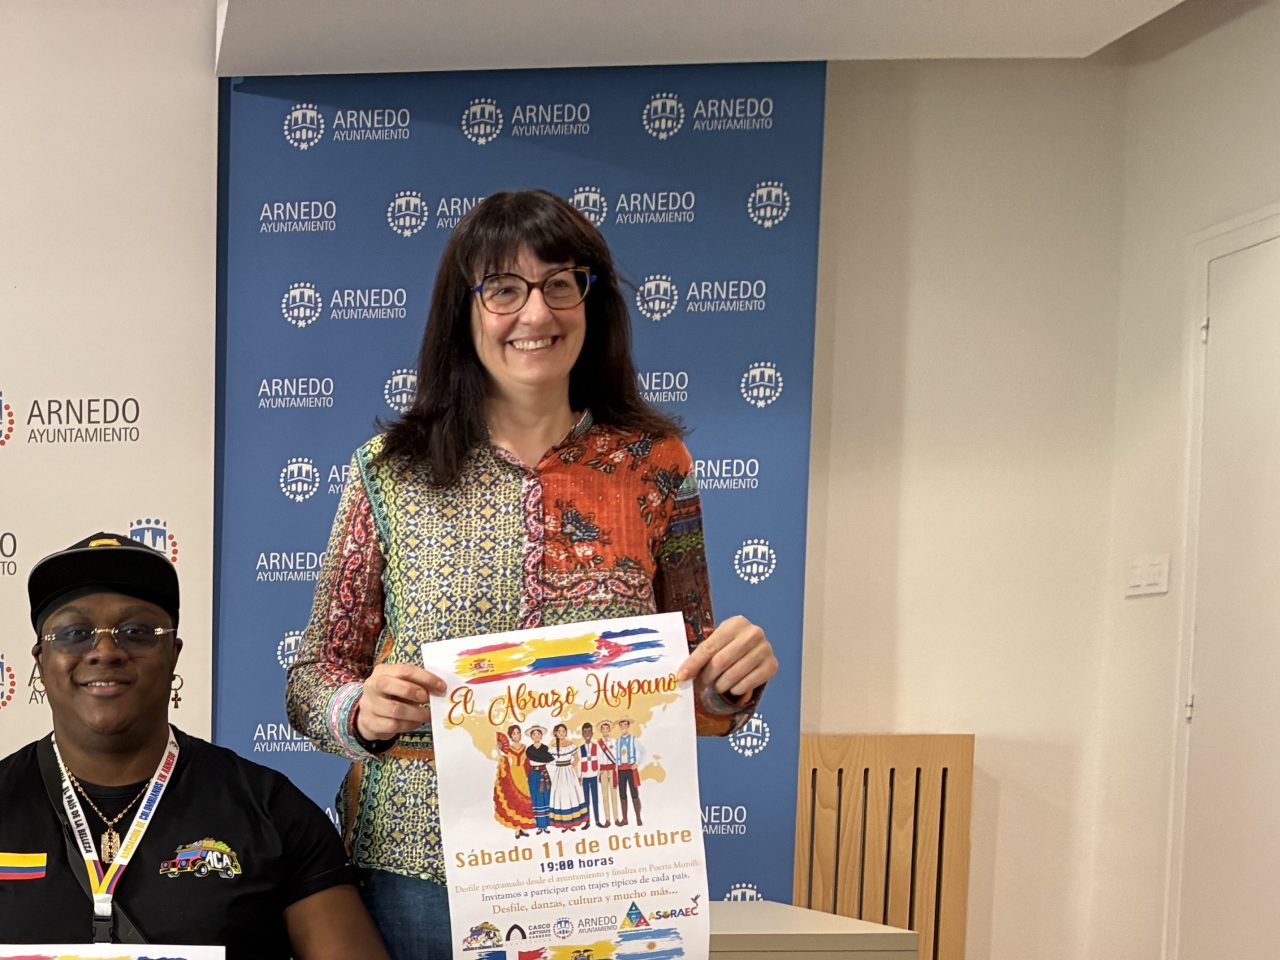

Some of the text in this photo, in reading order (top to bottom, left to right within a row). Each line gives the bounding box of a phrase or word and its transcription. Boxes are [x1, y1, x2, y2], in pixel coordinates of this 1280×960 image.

[512, 104, 590, 123] ARNEDO
[694, 98, 773, 117] ARNEDO
[333, 109, 409, 128] ARNEDO
[694, 118, 772, 130] AYUNTAMIENTO
[334, 129, 409, 140] AYUNTAMIENTO
[512, 124, 589, 136] AYUNTAMIENTO
[260, 201, 336, 220] ARNEDO
[616, 192, 695, 211] ARNEDO
[260, 221, 336, 232] AYUNTAMIENTO
[616, 212, 694, 223] AYUNTAMIENTO
[330, 289, 406, 307] ARNEDO
[687, 280, 766, 299] ARNEDO
[331, 308, 406, 319] AYUNTAMIENTO
[687, 300, 765, 311] AYUNTAMIENTO
[258, 378, 333, 396] ARNEDO
[27, 398, 139, 425] ARNEDO
[259, 397, 333, 408] AYUNTAMIENTO
[28, 427, 139, 443] AYUNTAMIENTO
[695, 459, 759, 478] RNEDO
[449, 674, 682, 726] El Abrazo Hispano
[700, 805, 747, 823] NEDO
[77, 828, 93, 854] BELLEZA
[456, 830, 691, 868] Sábado 11 de Octubre
[205, 851, 231, 868] ACA
[541, 857, 614, 872] 19:00 horas
[578, 916, 617, 928] ARNEDO
